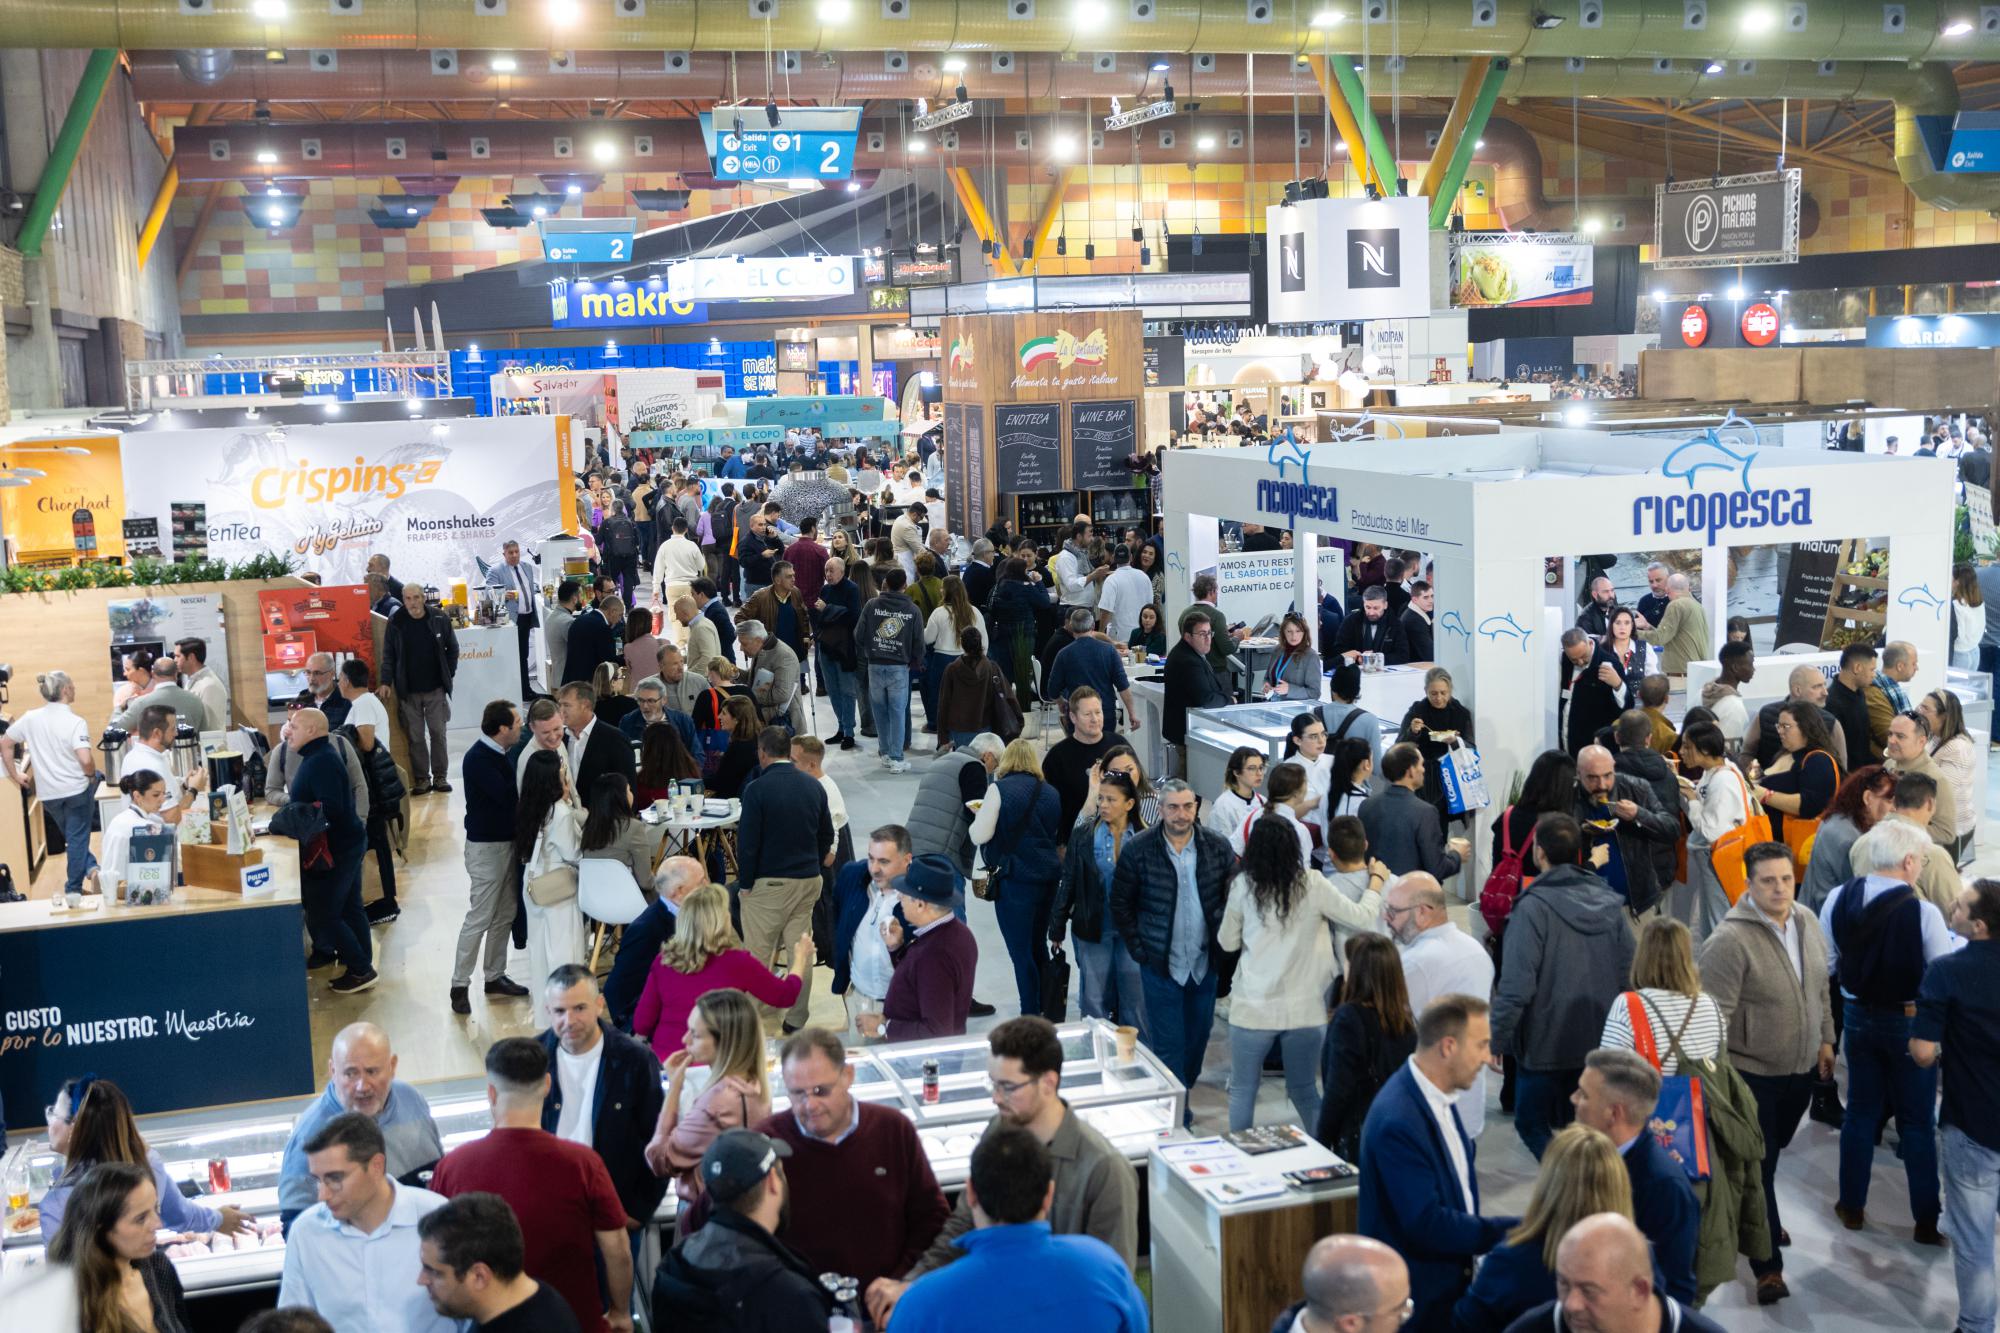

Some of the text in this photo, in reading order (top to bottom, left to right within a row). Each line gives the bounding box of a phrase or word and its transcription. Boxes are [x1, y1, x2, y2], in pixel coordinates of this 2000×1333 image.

[743, 134, 766, 142] Salida
[792, 134, 801, 151] 1
[743, 144, 758, 152] Exit
[1966, 152, 1984, 160] Salida
[820, 141, 841, 173] 2
[610, 239, 624, 258] 2
[1143, 281, 1249, 297] europastry
[582, 288, 694, 318] makro
[533, 378, 578, 394] Salvador
[744, 376, 758, 391] SE
[1011, 374, 1048, 388] Alimenta
[1062, 376, 1086, 390] gusto
[1088, 372, 1118, 385] italiano
[636, 402, 679, 419] Hacemos
[1080, 410, 1127, 423] WINE BAR
[1005, 412, 1050, 426] ENOTECA
[664, 433, 704, 442] EL COPO
[741, 430, 780, 440] EL COPO
[1256, 479, 1339, 530] ricopesca
[407, 514, 496, 532] Moonshakes
[1352, 510, 1430, 536] Productos del Mar
[1633, 488, 1812, 547] ricopesca
[407, 532, 448, 542] FRAPPES
[460, 528, 496, 539] SHAKES
[1219, 561, 1246, 570] AMOS
[1248, 560, 1255, 568] A
[1258, 560, 1268, 568] TU
[1224, 572, 1234, 580] EL
[1238, 569, 1270, 578] SABOR
[1272, 568, 1288, 576] DEL
[1221, 582, 1268, 594] GARANTÍA
[1270, 582, 1282, 590] DE
[248, 870, 268, 882] PULEVA
[6, 1006, 62, 1032] GUSTO
[0, 1008, 256, 1057] por lo NUESTRO: Maestría
